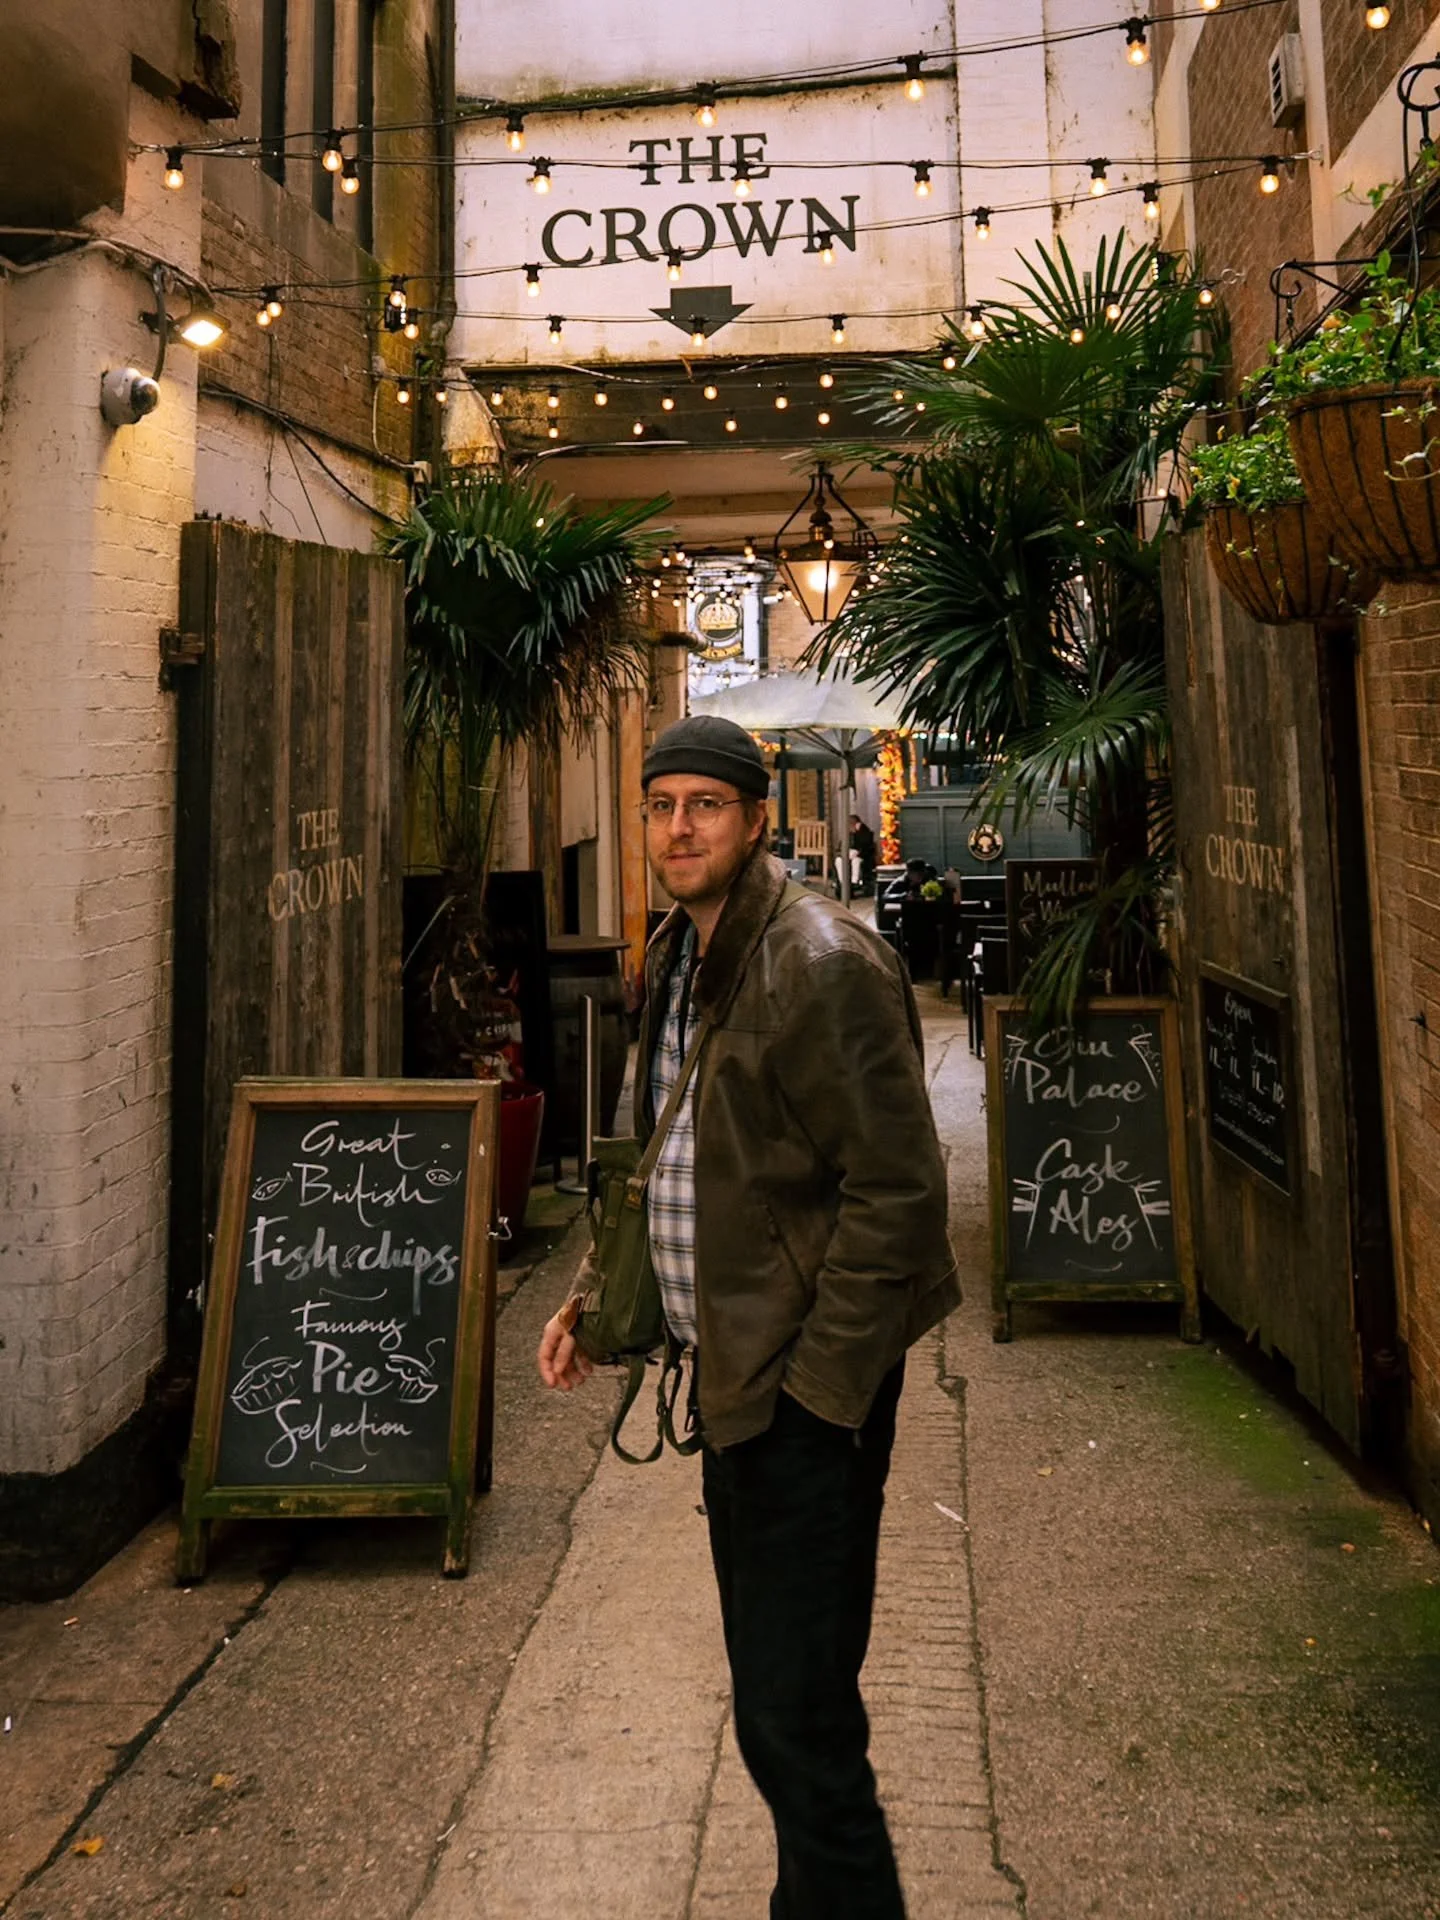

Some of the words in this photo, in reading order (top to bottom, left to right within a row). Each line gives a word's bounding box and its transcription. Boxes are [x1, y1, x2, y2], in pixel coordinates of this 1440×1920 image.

[629, 132, 771, 186] THE
[541, 195, 860, 268] CROWN
[296, 808, 340, 851] THE
[1223, 785, 1258, 826] THE
[267, 854, 364, 921] CROWN
[1206, 833, 1285, 896] CROWN
[1017, 1056, 1147, 1108] Palace
[301, 1118, 426, 1170] Great
[1035, 1138, 1144, 1194] Cask
[292, 1163, 444, 1227] British
[1049, 1189, 1139, 1252] Ales
[291, 1300, 407, 1351] Famous
[304, 1340, 394, 1396] Pie
[265, 1399, 412, 1468] Selection
